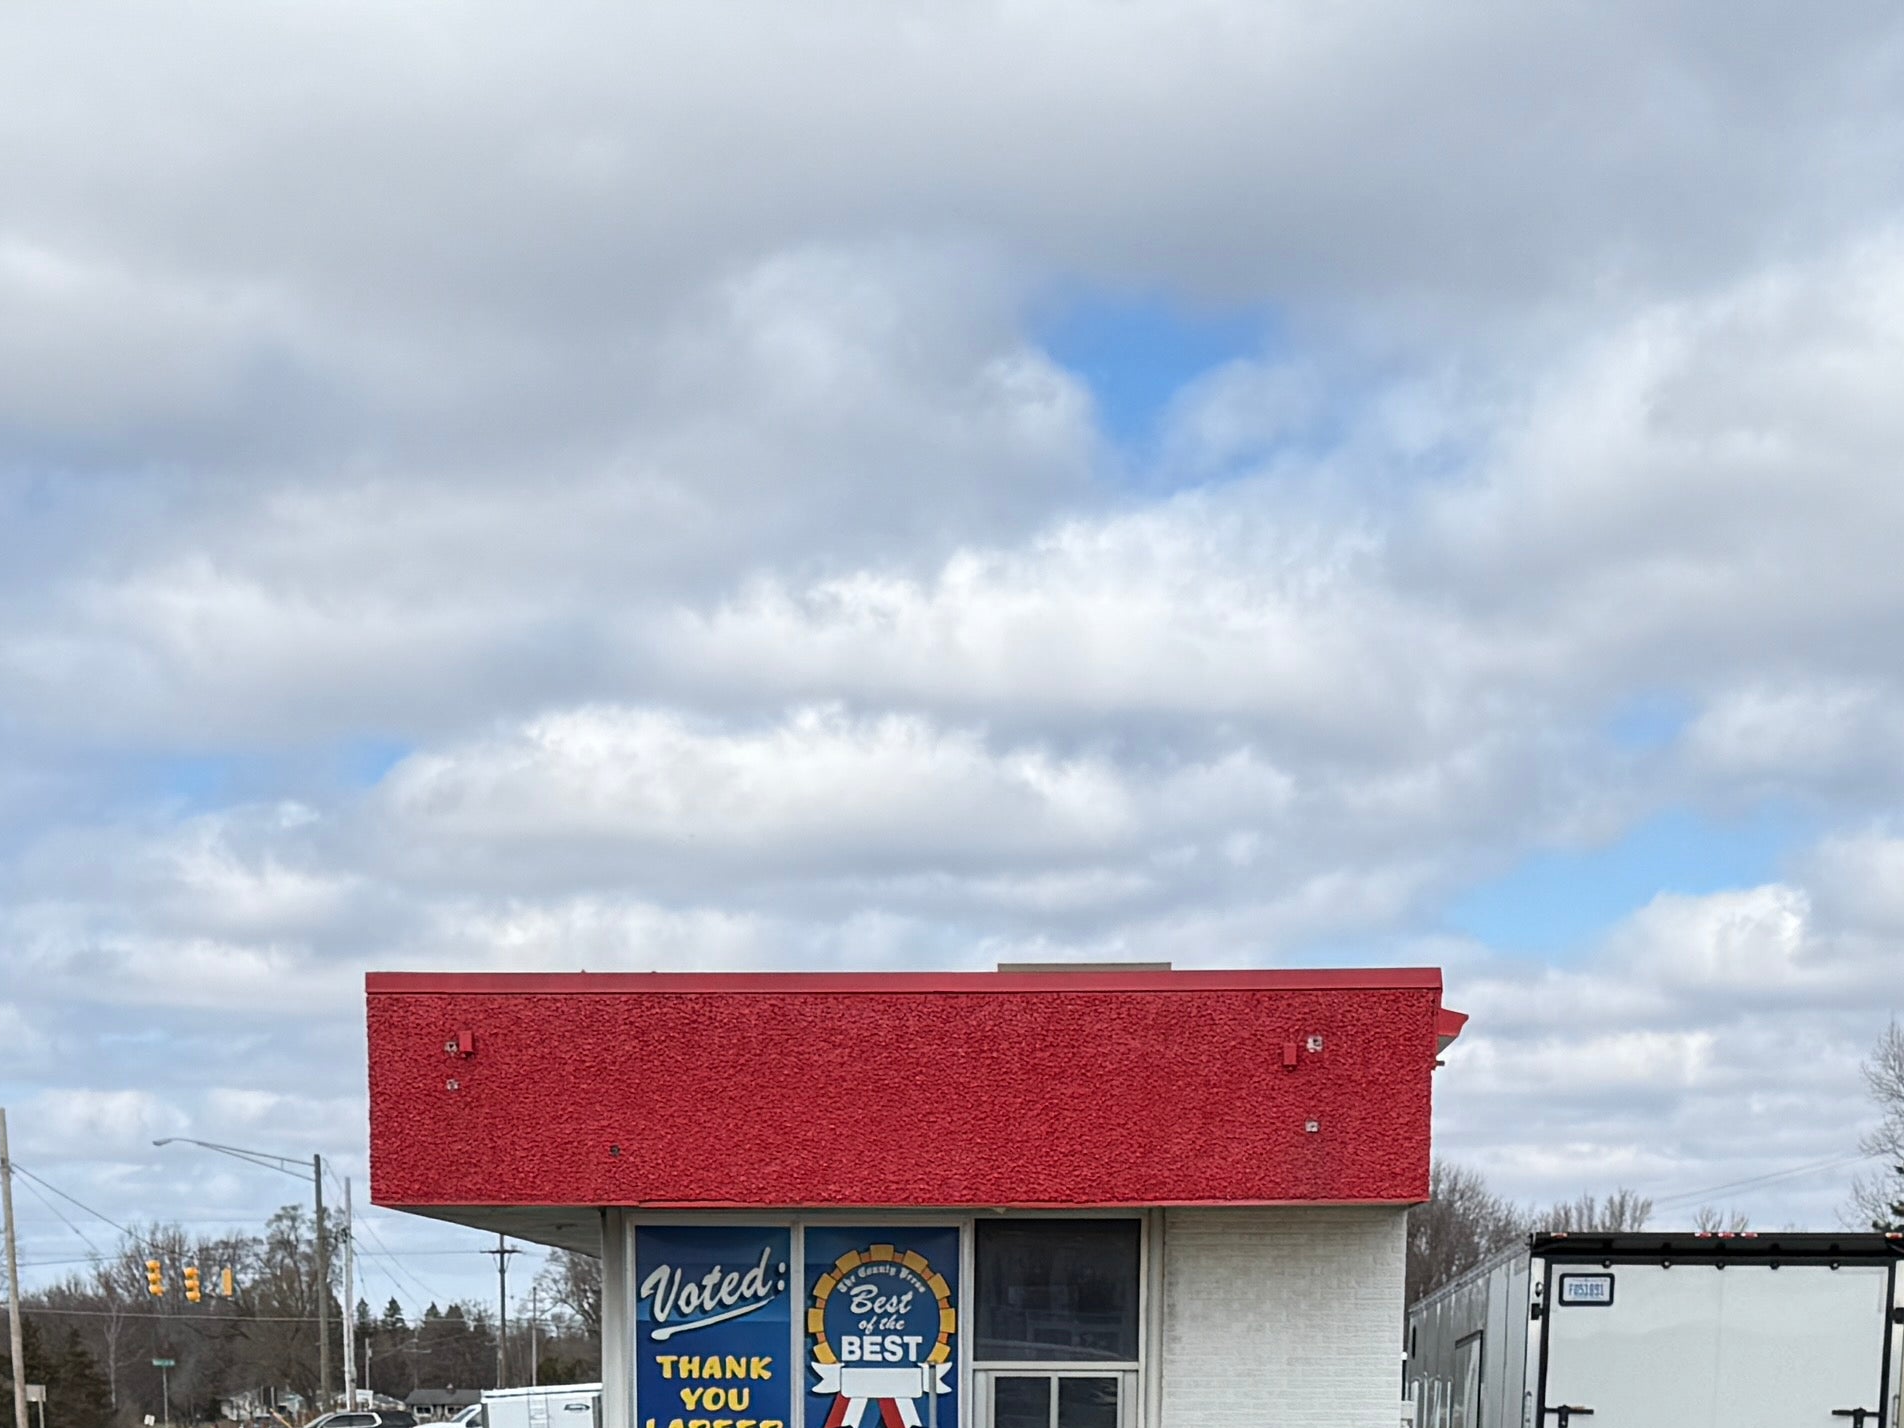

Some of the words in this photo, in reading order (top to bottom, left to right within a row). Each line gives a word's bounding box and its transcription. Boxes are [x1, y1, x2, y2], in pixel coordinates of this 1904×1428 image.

[640, 1246, 787, 1323] Voted:
[849, 1284, 913, 1314] Best
[858, 1315, 877, 1335] of
[879, 1314, 905, 1330] the
[841, 1335, 923, 1362] BEST
[656, 1355, 773, 1380] THANK
[680, 1387, 750, 1411] YOU
